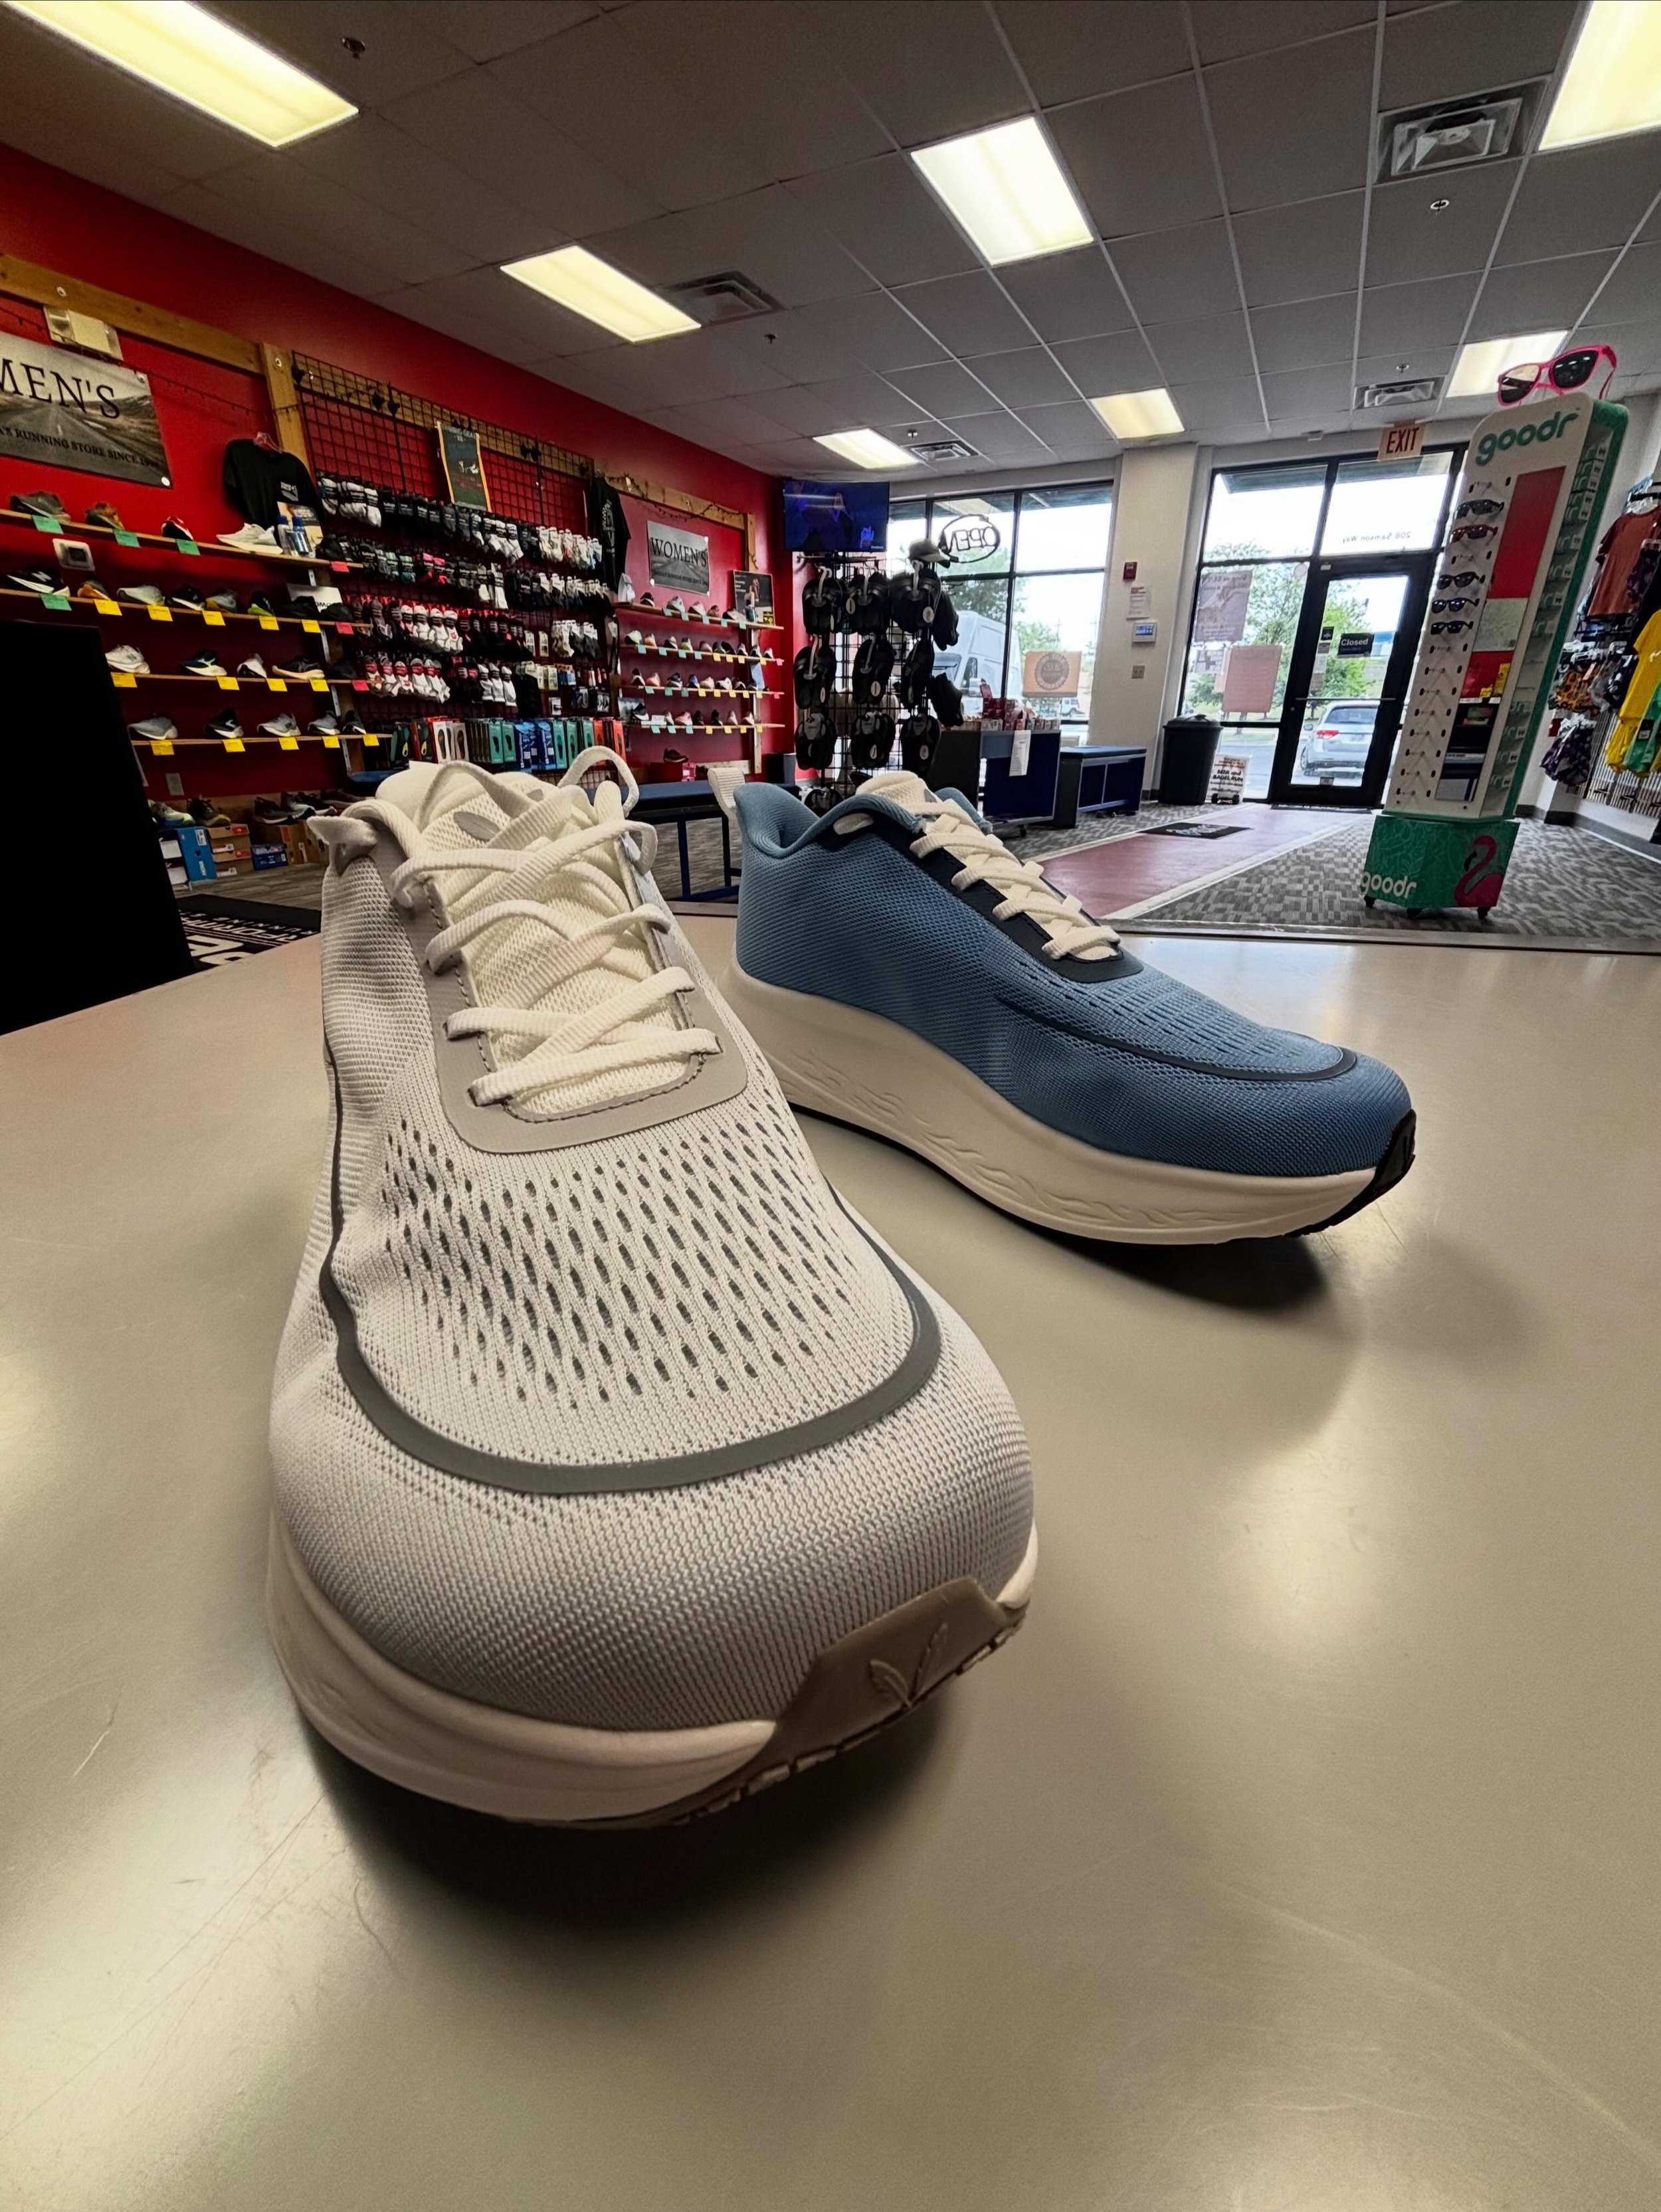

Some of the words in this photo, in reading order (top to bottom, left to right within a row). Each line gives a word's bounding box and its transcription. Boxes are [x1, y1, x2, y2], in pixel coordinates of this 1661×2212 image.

[16, 430, 68, 449] RUNNING
[71, 441, 105, 457] STORE
[108, 450, 138, 464] SINCE
[1386, 427, 1420, 454] EXIT
[1476, 411, 1579, 466] goodr
[650, 537, 707, 567] WOMEN'S
[1341, 638, 1369, 646] Closed
[1359, 871, 1417, 899] goodr
